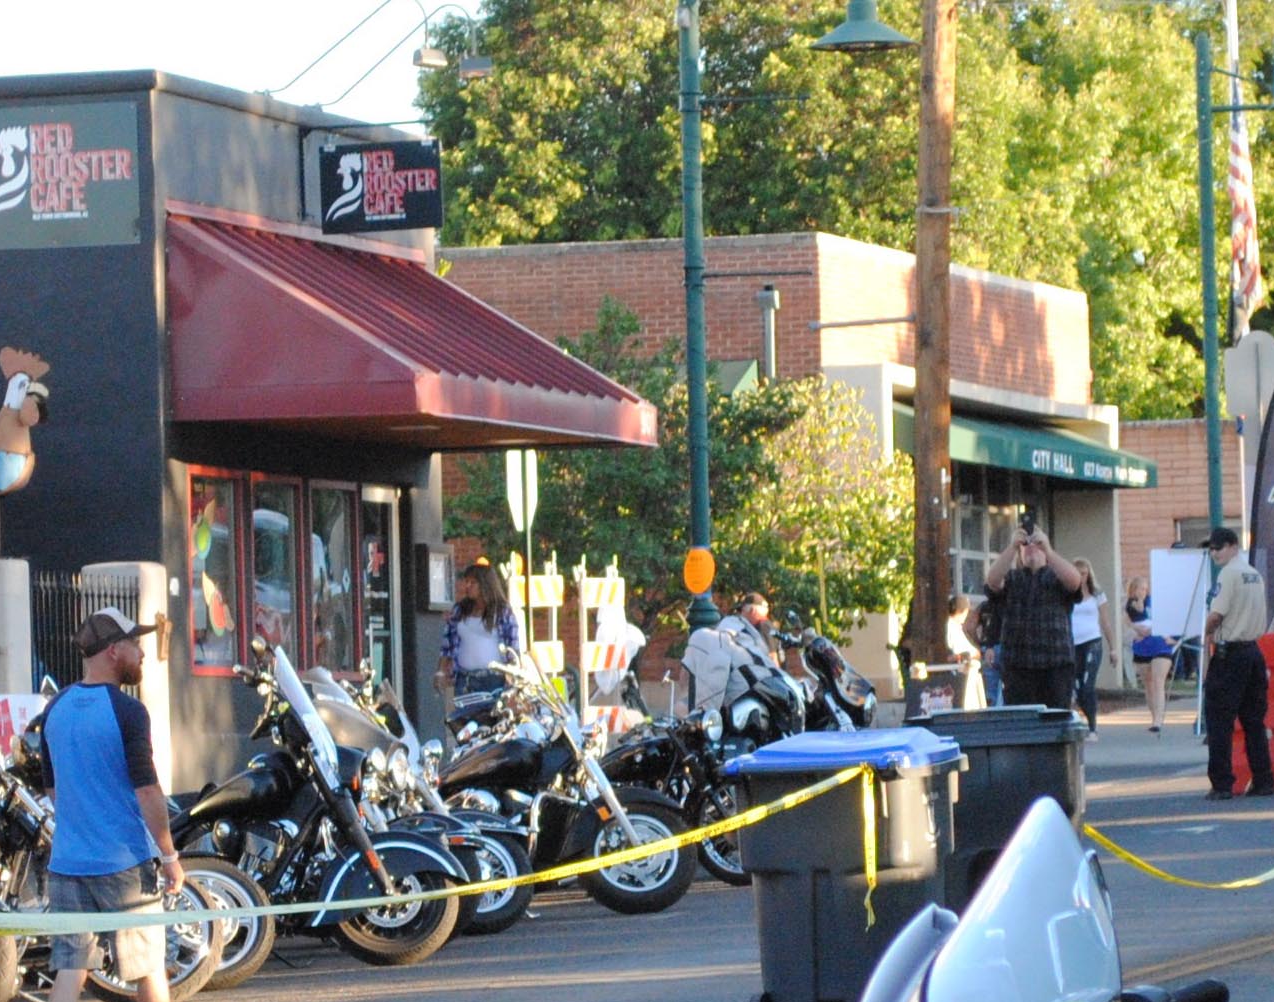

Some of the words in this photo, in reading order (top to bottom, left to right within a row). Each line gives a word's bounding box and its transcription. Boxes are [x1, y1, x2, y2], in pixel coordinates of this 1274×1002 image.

[29, 122, 74, 155] RED
[30, 147, 133, 184] ROOSTER
[362, 149, 396, 173] RED
[30, 179, 88, 213] CAFE
[363, 167, 438, 196] ROOSTER
[363, 190, 406, 215] CAFE
[1032, 449, 1052, 471] CITY
[1053, 452, 1075, 475] HALL
